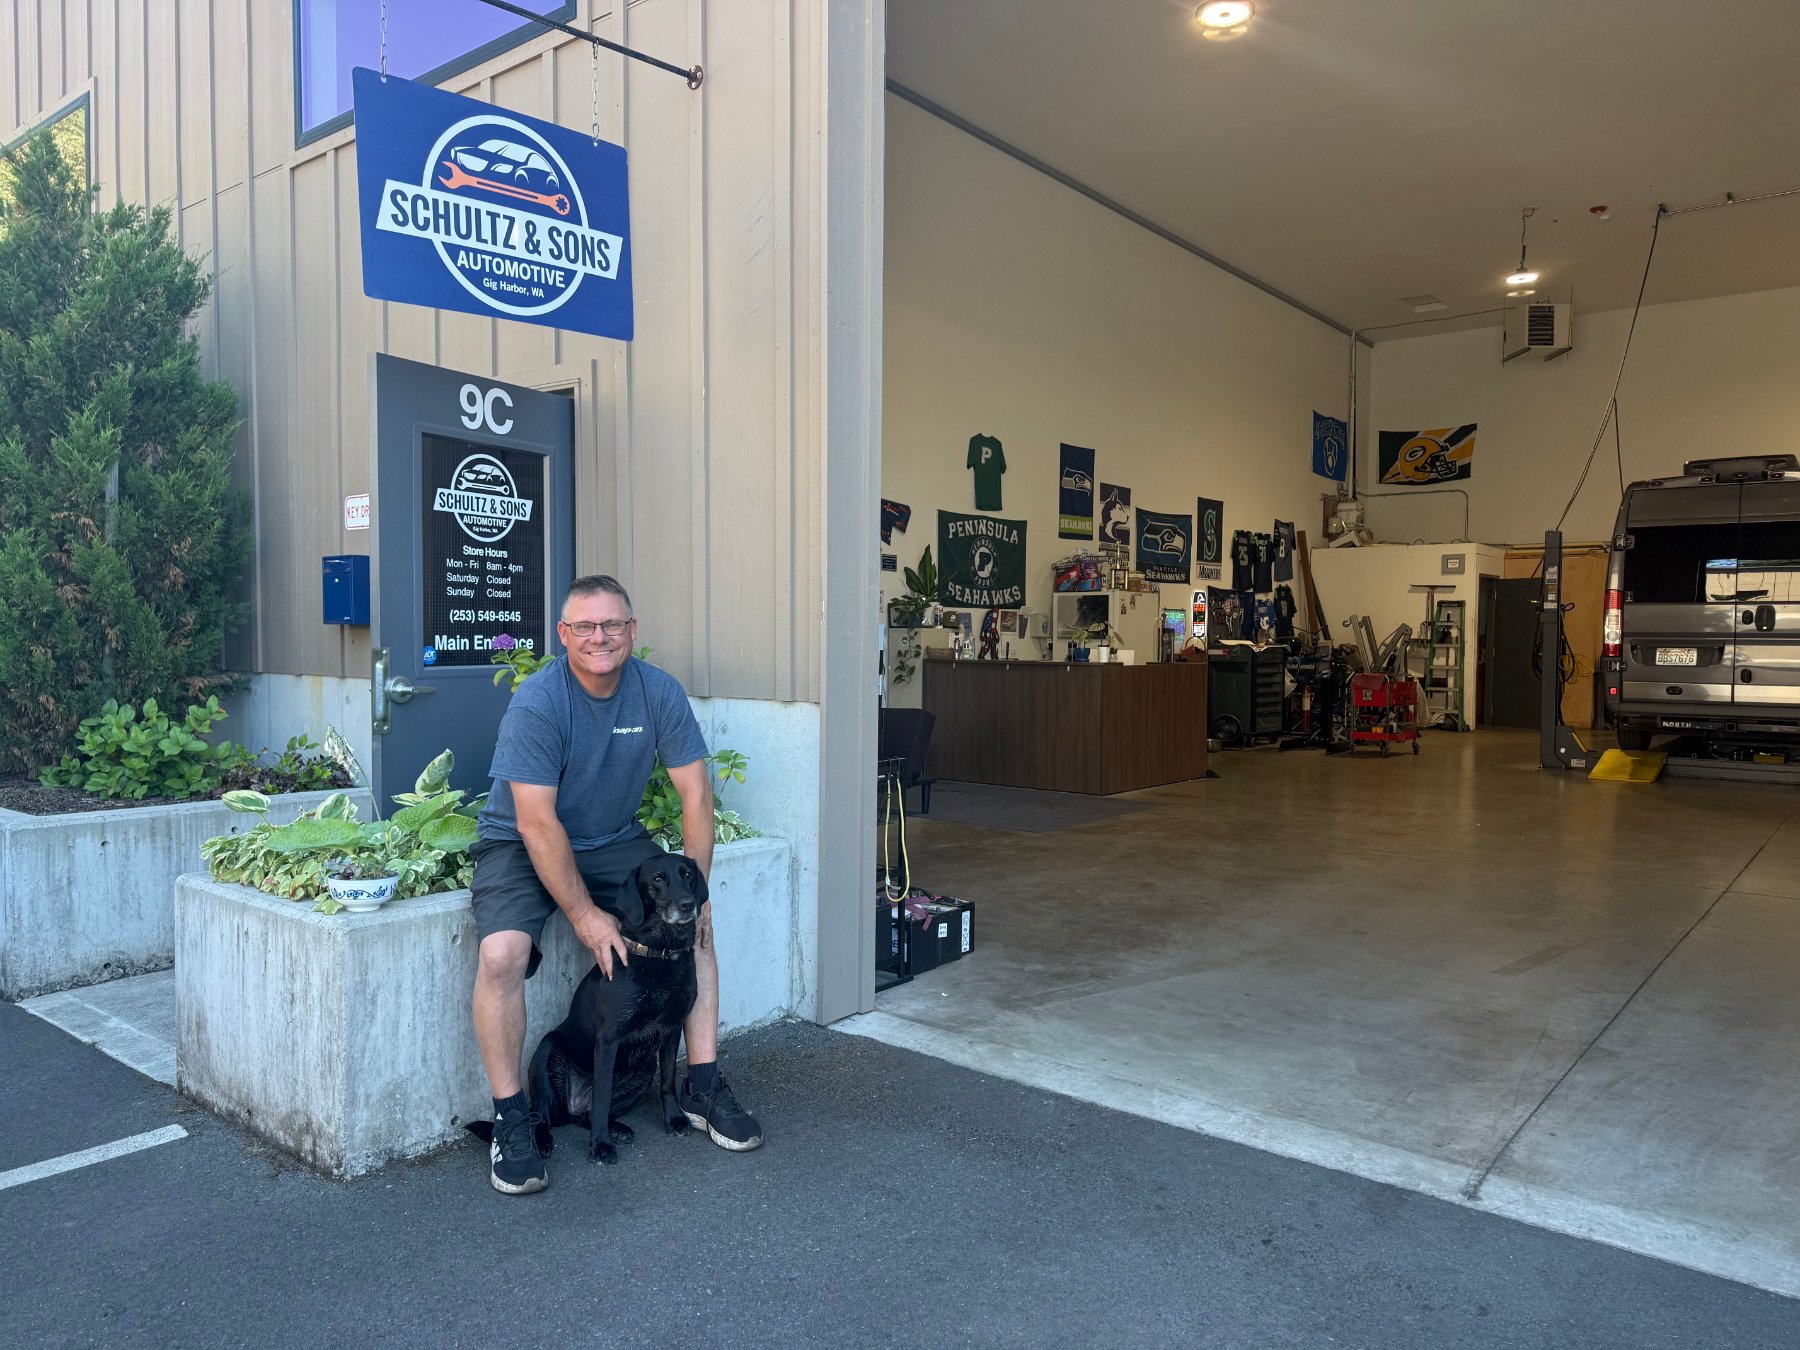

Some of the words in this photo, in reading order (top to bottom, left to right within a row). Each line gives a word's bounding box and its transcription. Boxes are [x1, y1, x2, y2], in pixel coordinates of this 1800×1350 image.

[389, 188, 517, 250] SCHULTZ
[524, 219, 542, 256] &
[547, 225, 611, 272] SONS
[456, 249, 566, 288] AUTOMOTIVE
[482, 277, 498, 291] Gig
[500, 279, 529, 297] Harbor,
[531, 286, 545, 298] WA
[459, 383, 514, 435] 9C
[981, 446, 992, 465] P
[438, 491, 487, 513] SCHULTZ
[490, 498, 498, 515] &
[500, 499, 527, 518] SONS
[463, 515, 508, 528] AUTOMOTIVE
[948, 519, 1019, 545] PENINSULA
[462, 545, 484, 556] Store
[485, 547, 508, 558] Hours
[446, 558, 463, 568] Mon
[469, 560, 479, 569] Fri
[486, 561, 503, 570] 8am
[508, 563, 524, 574] 4pm
[446, 572, 480, 585] Saturday
[486, 575, 511, 585] Closed
[1146, 569, 1186, 581] SEAHAWKS
[446, 586, 475, 598] Sunday
[486, 588, 511, 598] Closed
[946, 581, 1021, 606] SEAHAWKS
[449, 609, 476, 624] (253)
[477, 610, 522, 622] 549-6545
[434, 634, 470, 650] Main
[474, 634, 534, 650] Ennce
